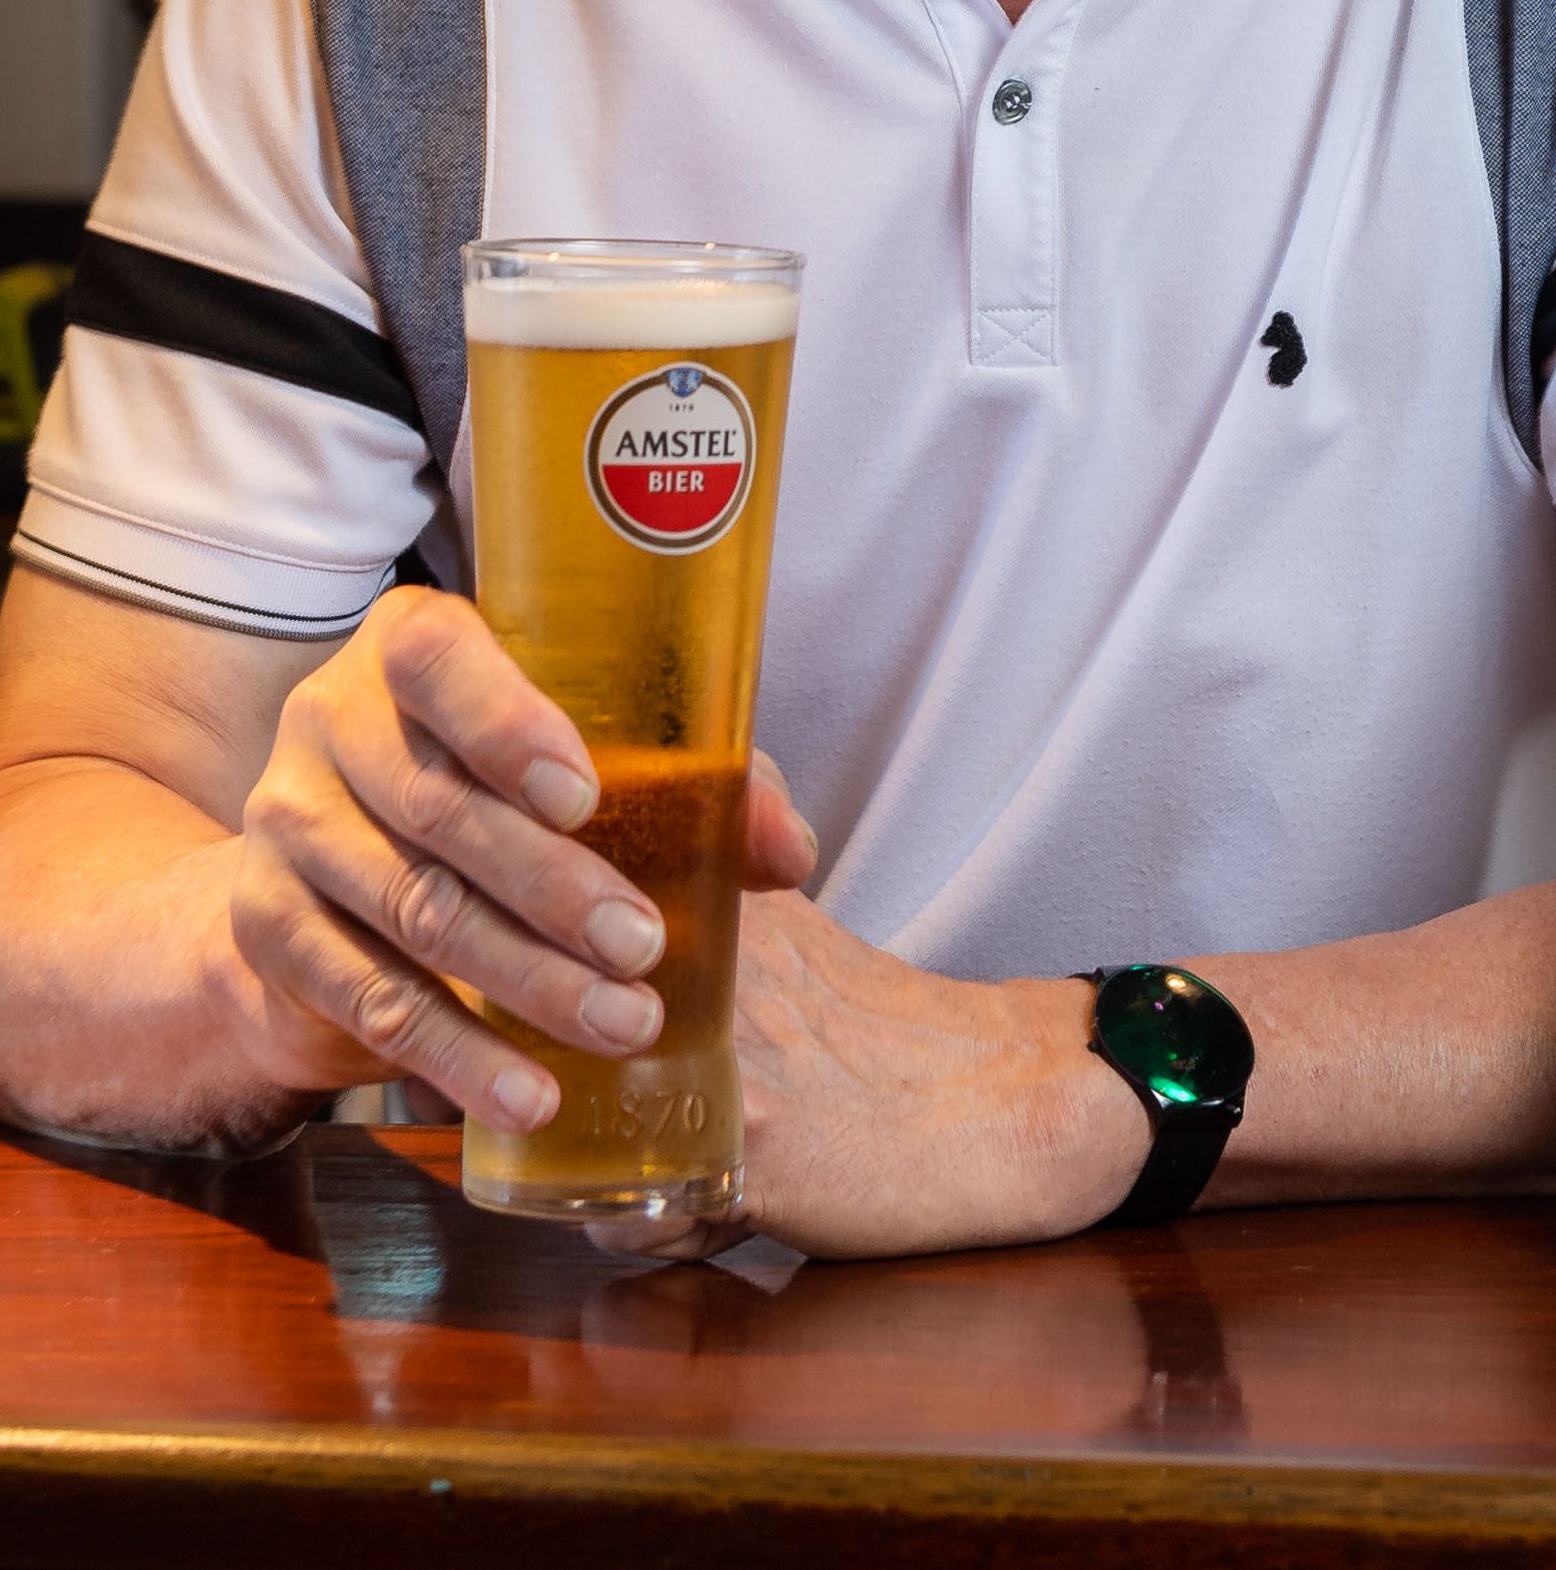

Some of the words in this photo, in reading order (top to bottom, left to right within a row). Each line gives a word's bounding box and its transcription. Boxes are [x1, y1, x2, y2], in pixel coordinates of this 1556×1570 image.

[615, 430, 735, 458] AMSTEL
[648, 470, 706, 493] BIER
[586, 1086, 708, 1140] 1870
